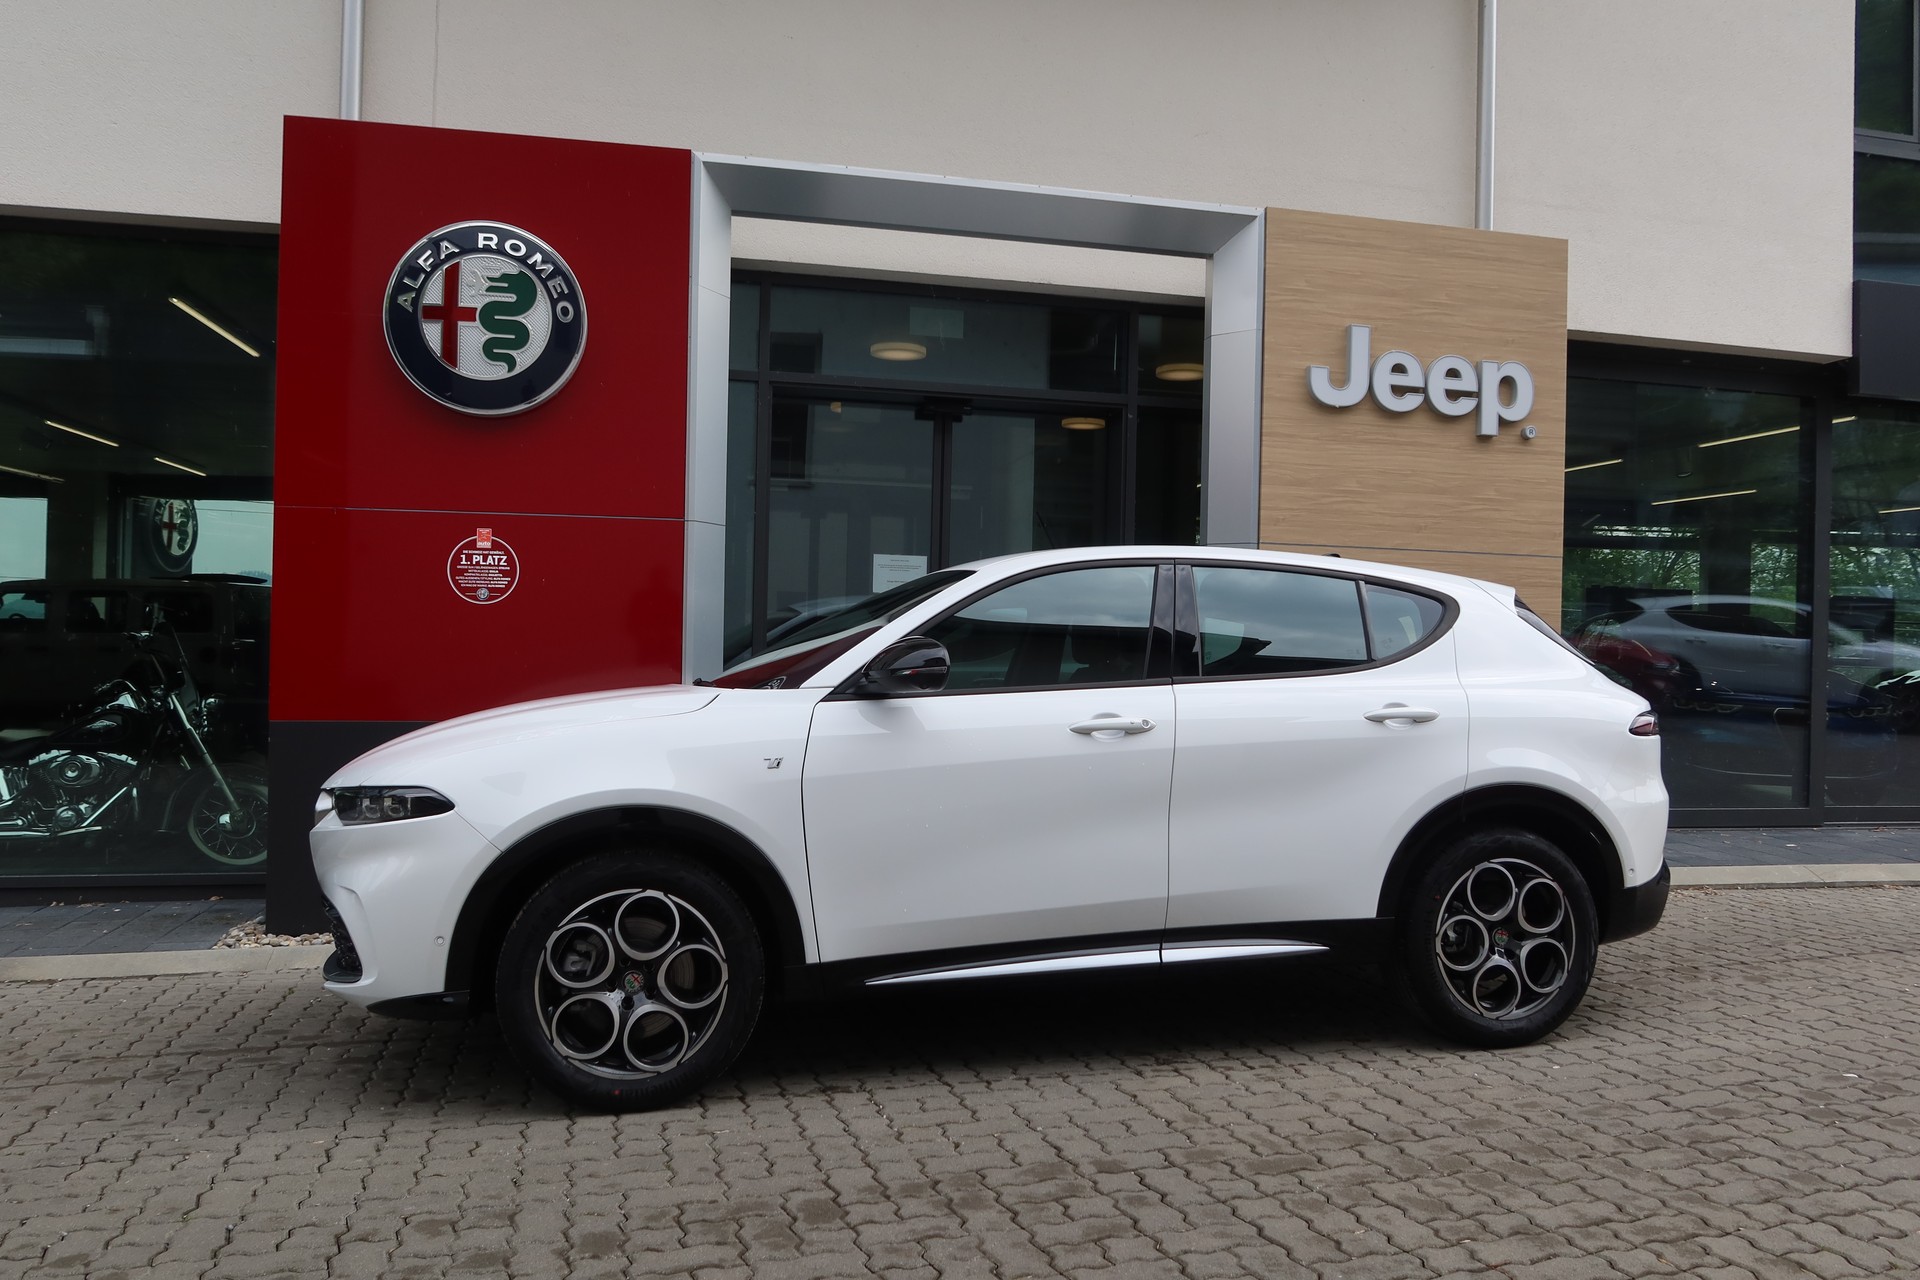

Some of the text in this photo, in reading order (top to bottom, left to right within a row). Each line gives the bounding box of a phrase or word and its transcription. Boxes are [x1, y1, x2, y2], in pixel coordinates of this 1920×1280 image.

[397, 232, 574, 323] ALFA ROMEO
[1306, 323, 1535, 438] Jeep
[460, 554, 508, 566] 1. PLATZ
